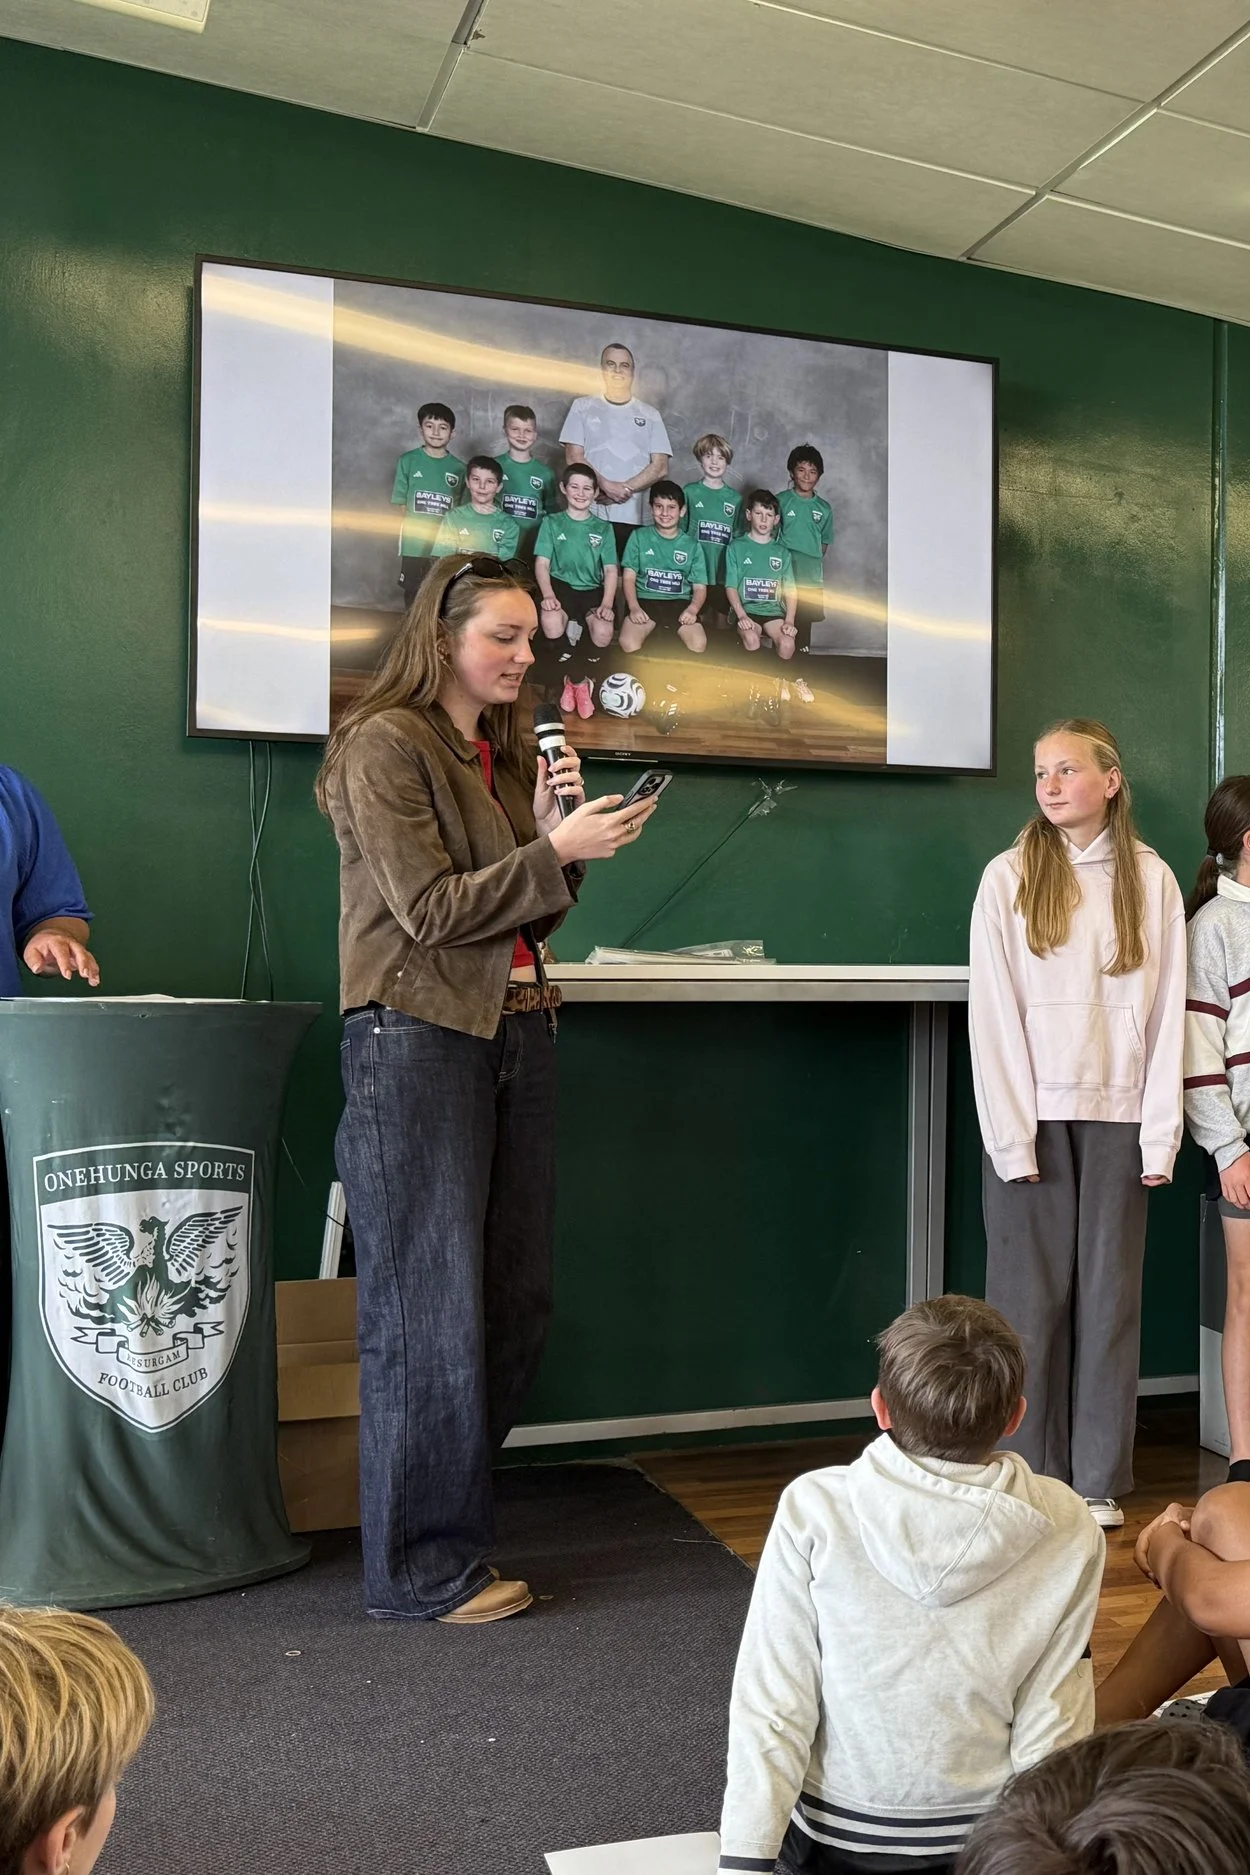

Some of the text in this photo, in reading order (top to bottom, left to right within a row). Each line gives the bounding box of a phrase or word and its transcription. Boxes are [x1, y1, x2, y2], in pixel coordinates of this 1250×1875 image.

[416, 490, 451, 503] BAYLEYS
[504, 496, 536, 507] BAYLEYS
[700, 521, 731, 533] BAYLEYS
[647, 569, 682, 580] BAYLEYS
[44, 1161, 246, 1192] ONEHUNGA SPORTS
[98, 1367, 208, 1398] FOOTBALL CLUB
